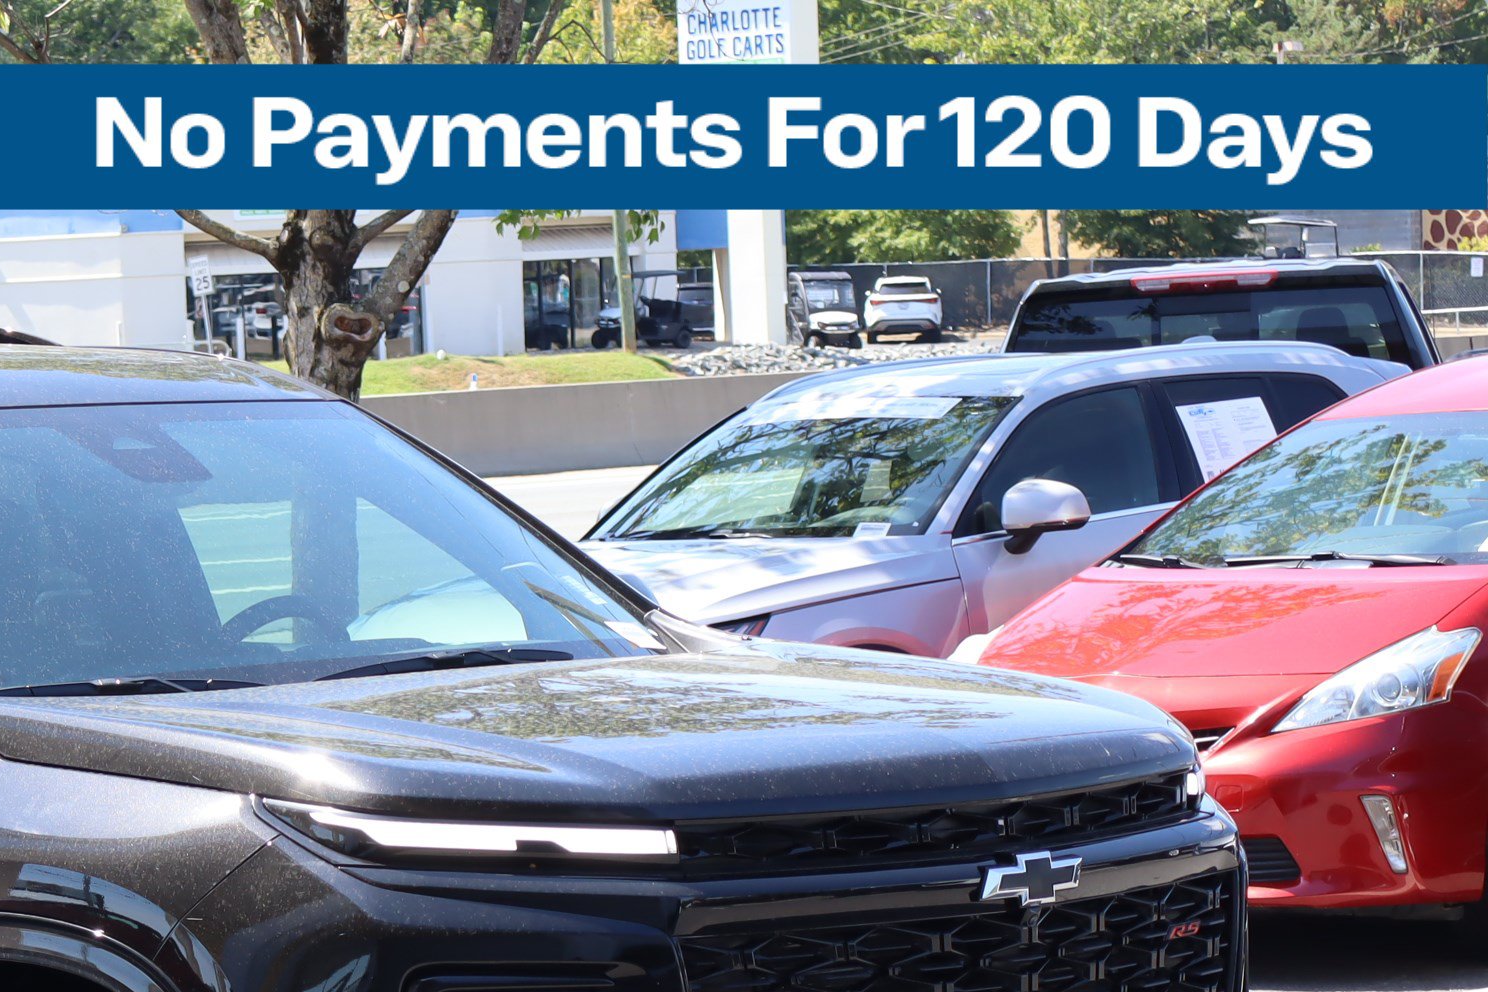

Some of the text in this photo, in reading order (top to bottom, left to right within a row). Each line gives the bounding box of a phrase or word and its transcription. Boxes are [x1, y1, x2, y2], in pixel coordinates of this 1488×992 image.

[686, 6, 782, 35] CHARLOTTE
[686, 33, 784, 60] GOLF CARTS
[195, 276, 210, 291] 25
[1169, 920, 1202, 940] RS
